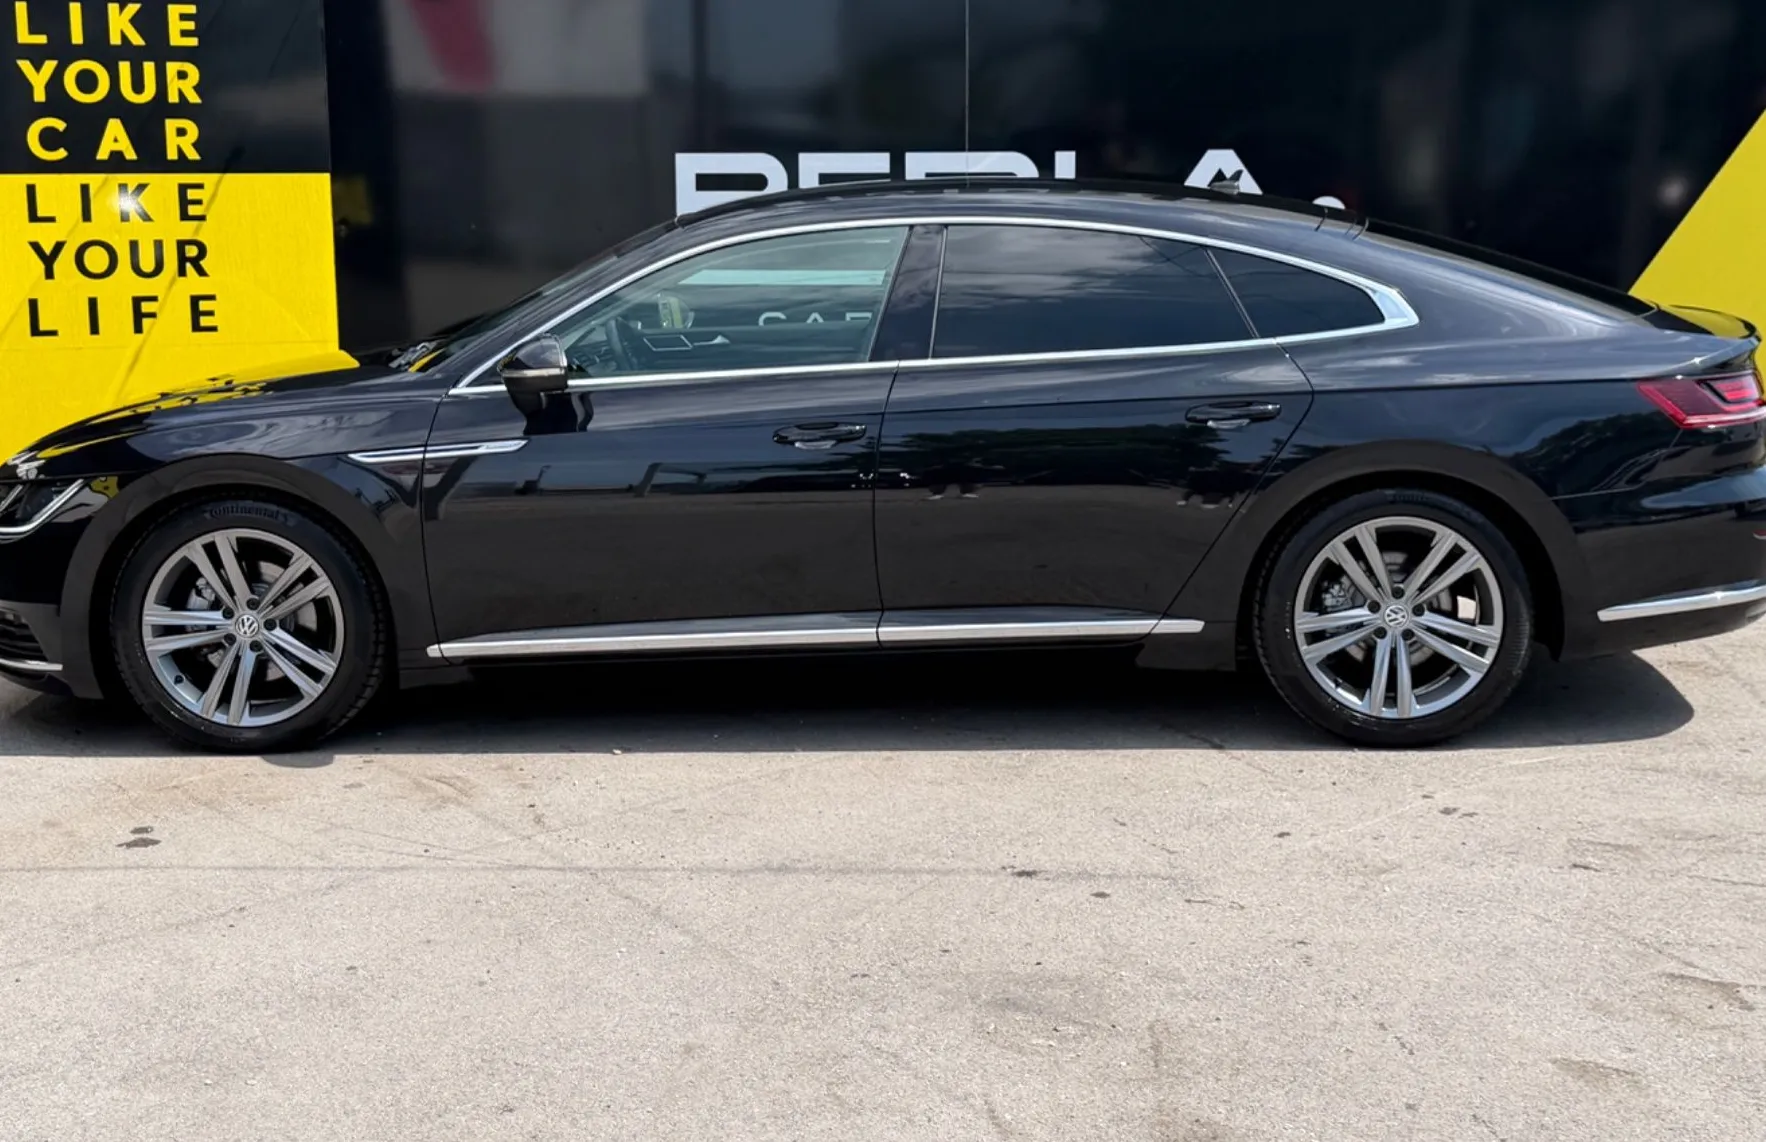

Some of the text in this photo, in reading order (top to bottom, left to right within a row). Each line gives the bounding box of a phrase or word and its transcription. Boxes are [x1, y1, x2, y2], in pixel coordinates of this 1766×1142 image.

[15, 1, 199, 46] LIKE
[16, 59, 202, 103] YOUR
[26, 117, 201, 161] CAR
[26, 183, 207, 223] LIKE
[27, 239, 210, 280] YOUR
[28, 294, 218, 337] LIFE
[208, 503, 281, 521] Continental
